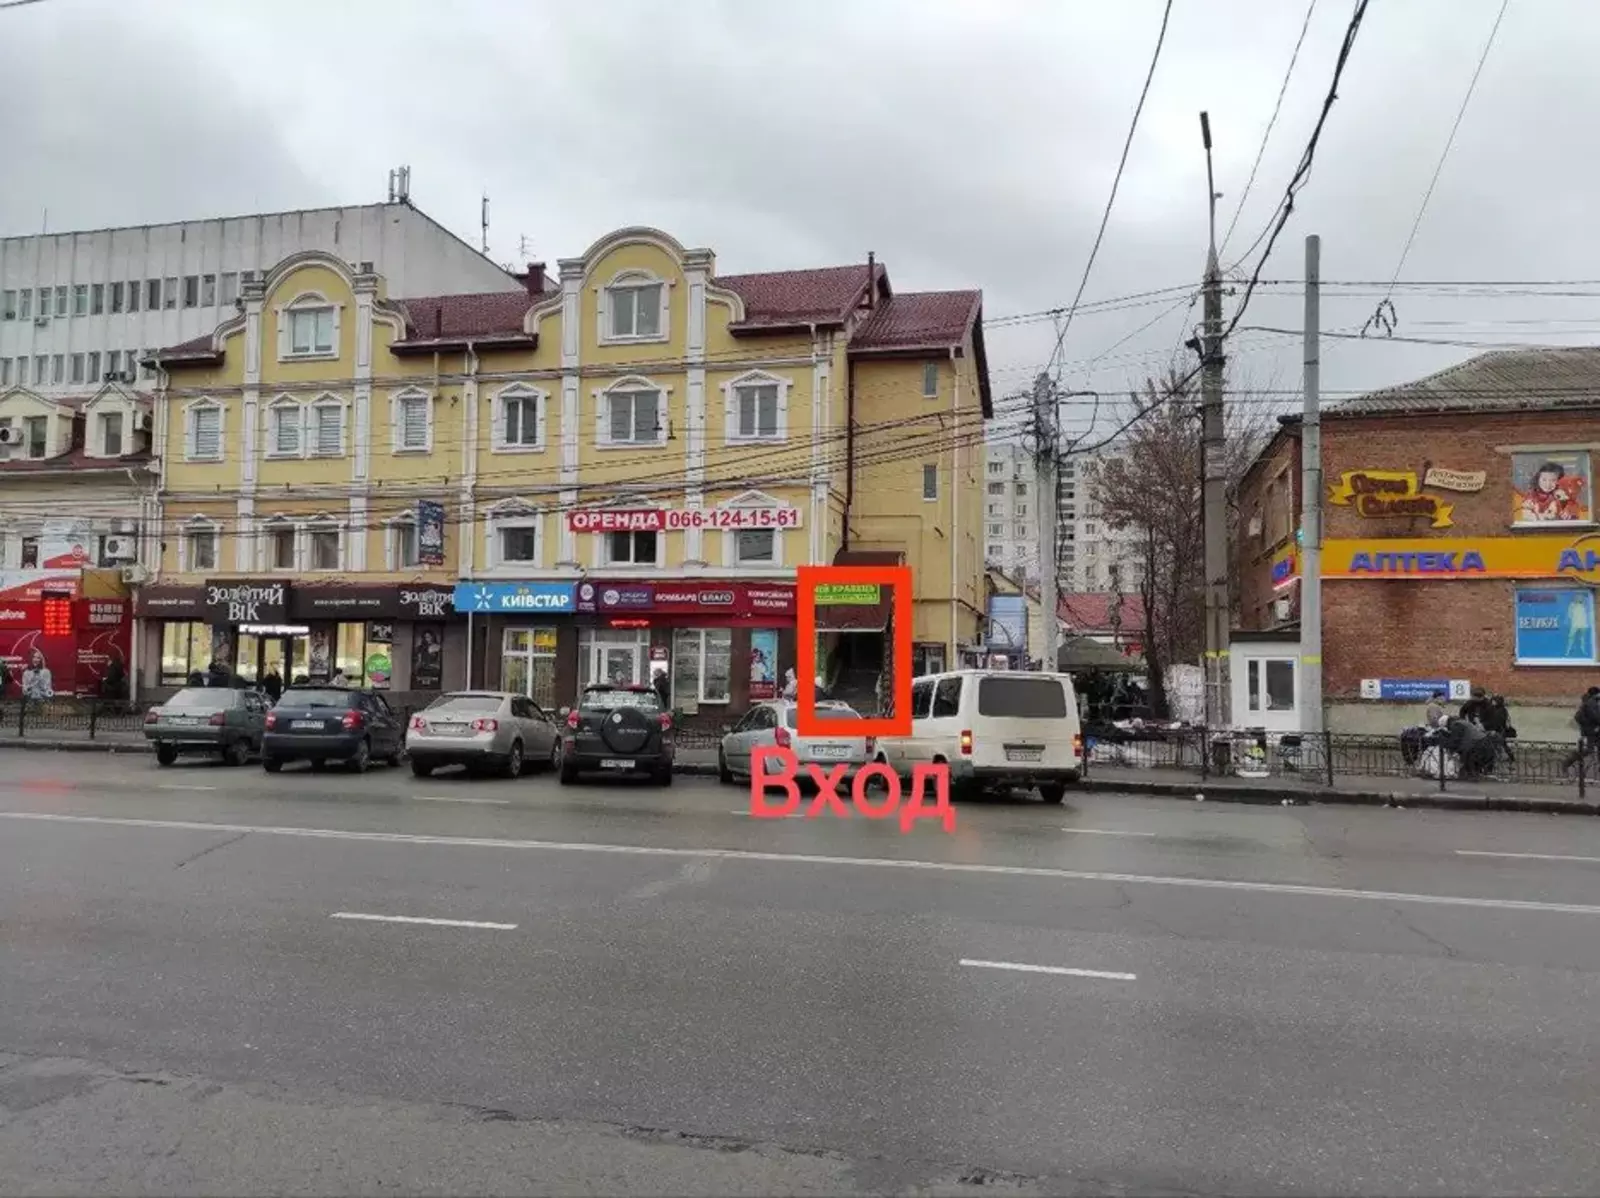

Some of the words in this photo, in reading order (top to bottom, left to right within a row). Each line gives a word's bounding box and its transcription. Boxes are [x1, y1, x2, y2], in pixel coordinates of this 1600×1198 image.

[572, 512, 661, 530] ОРЕНДА
[668, 508, 798, 528] 066-124-15-61
[1350, 550, 1487, 573] АПТЕКА
[502, 588, 569, 608] КИЇВСТАР
[1455, 683, 1464, 697] 8
